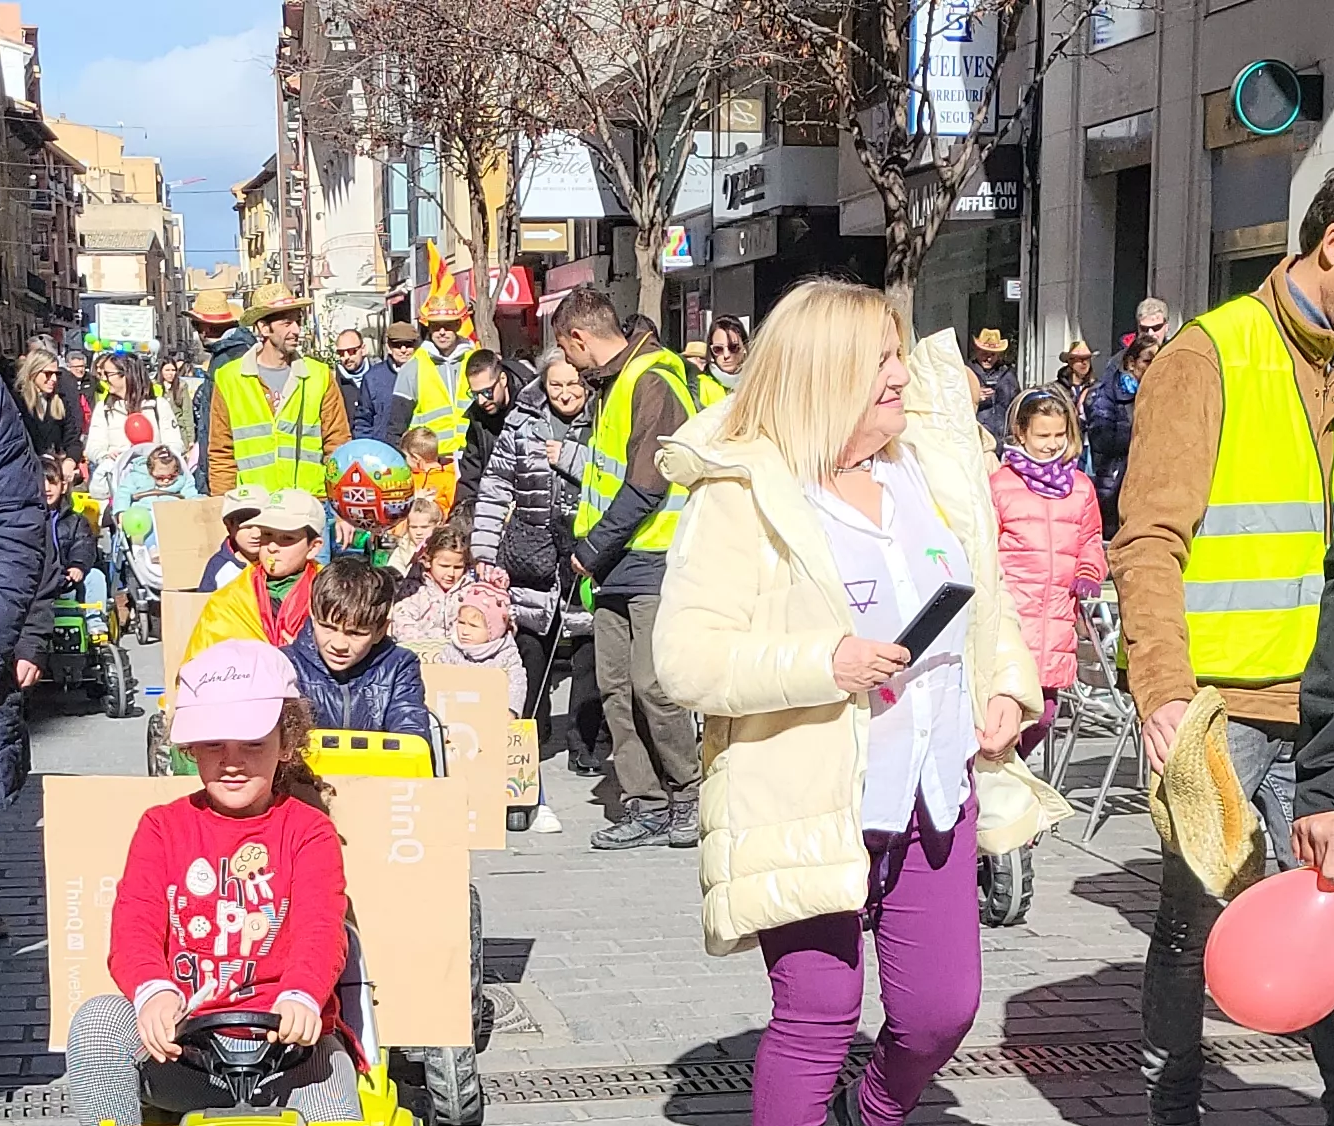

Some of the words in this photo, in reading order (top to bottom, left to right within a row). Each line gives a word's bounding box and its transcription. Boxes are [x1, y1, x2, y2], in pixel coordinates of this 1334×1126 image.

[928, 55, 994, 78] UELVES
[928, 87, 988, 102] ORREDURÍ
[939, 110, 989, 124] SEGURS
[977, 181, 1017, 196] ALAIN
[955, 196, 1017, 212] AFFLELOU
[387, 780, 425, 864] hinQ
[64, 875, 84, 931] ThinQ
[67, 964, 85, 1019] webO
